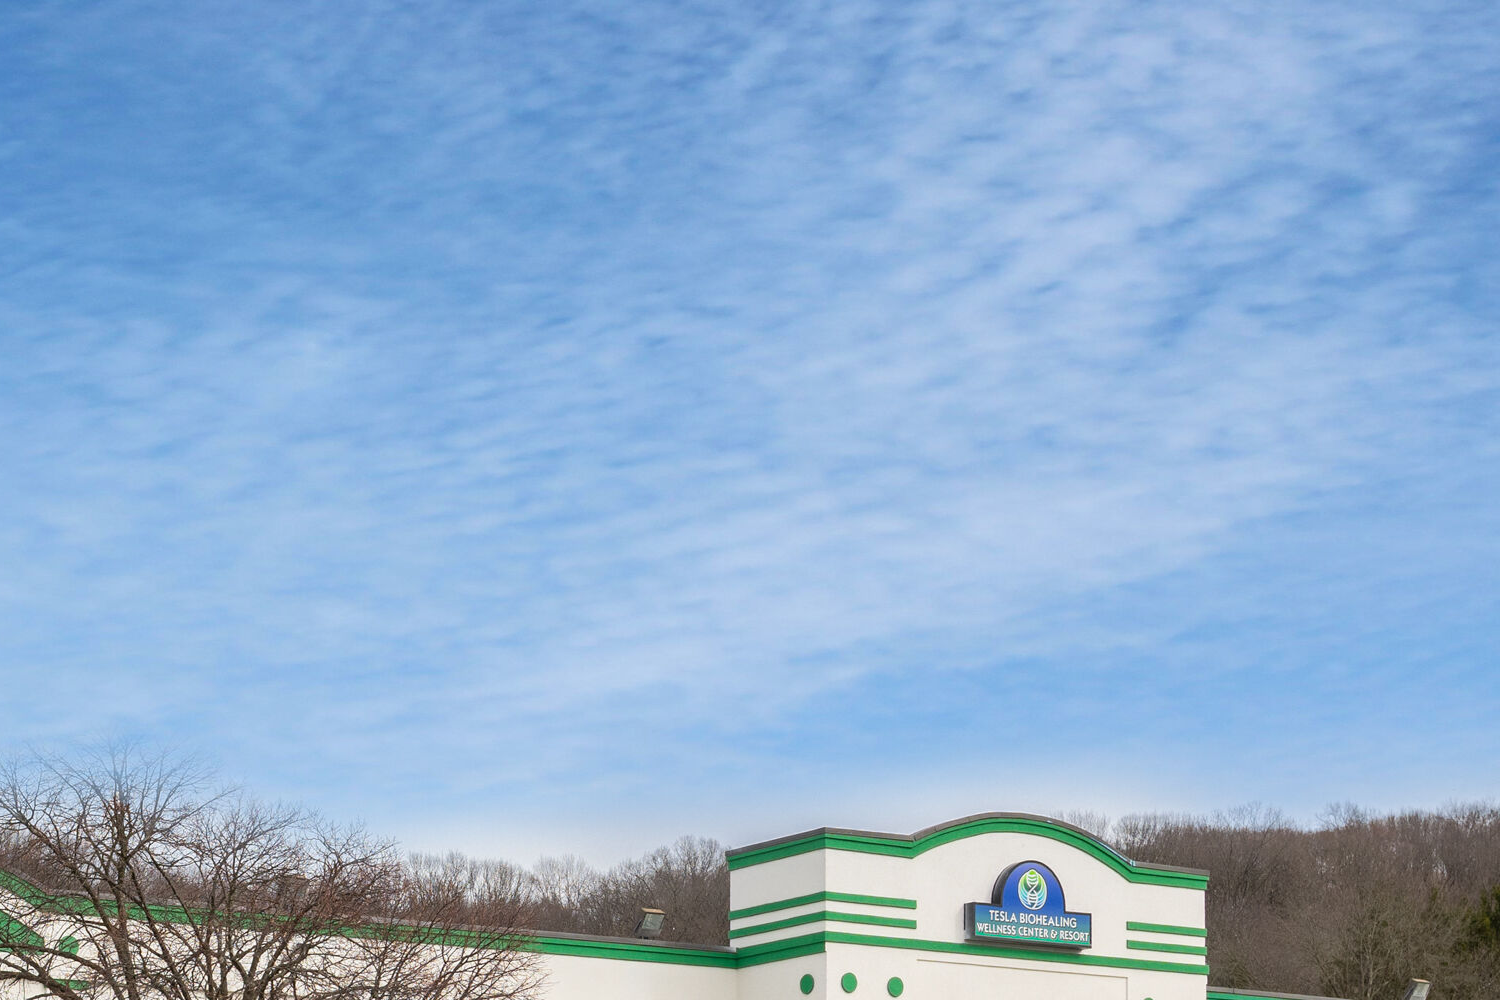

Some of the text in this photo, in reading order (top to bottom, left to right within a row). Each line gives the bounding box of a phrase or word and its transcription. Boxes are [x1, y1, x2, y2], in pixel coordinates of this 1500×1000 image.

[989, 910, 1077, 928] TESLA BIOHEALING
[977, 922, 1089, 942] WELLNESS CENTER & RESORT
